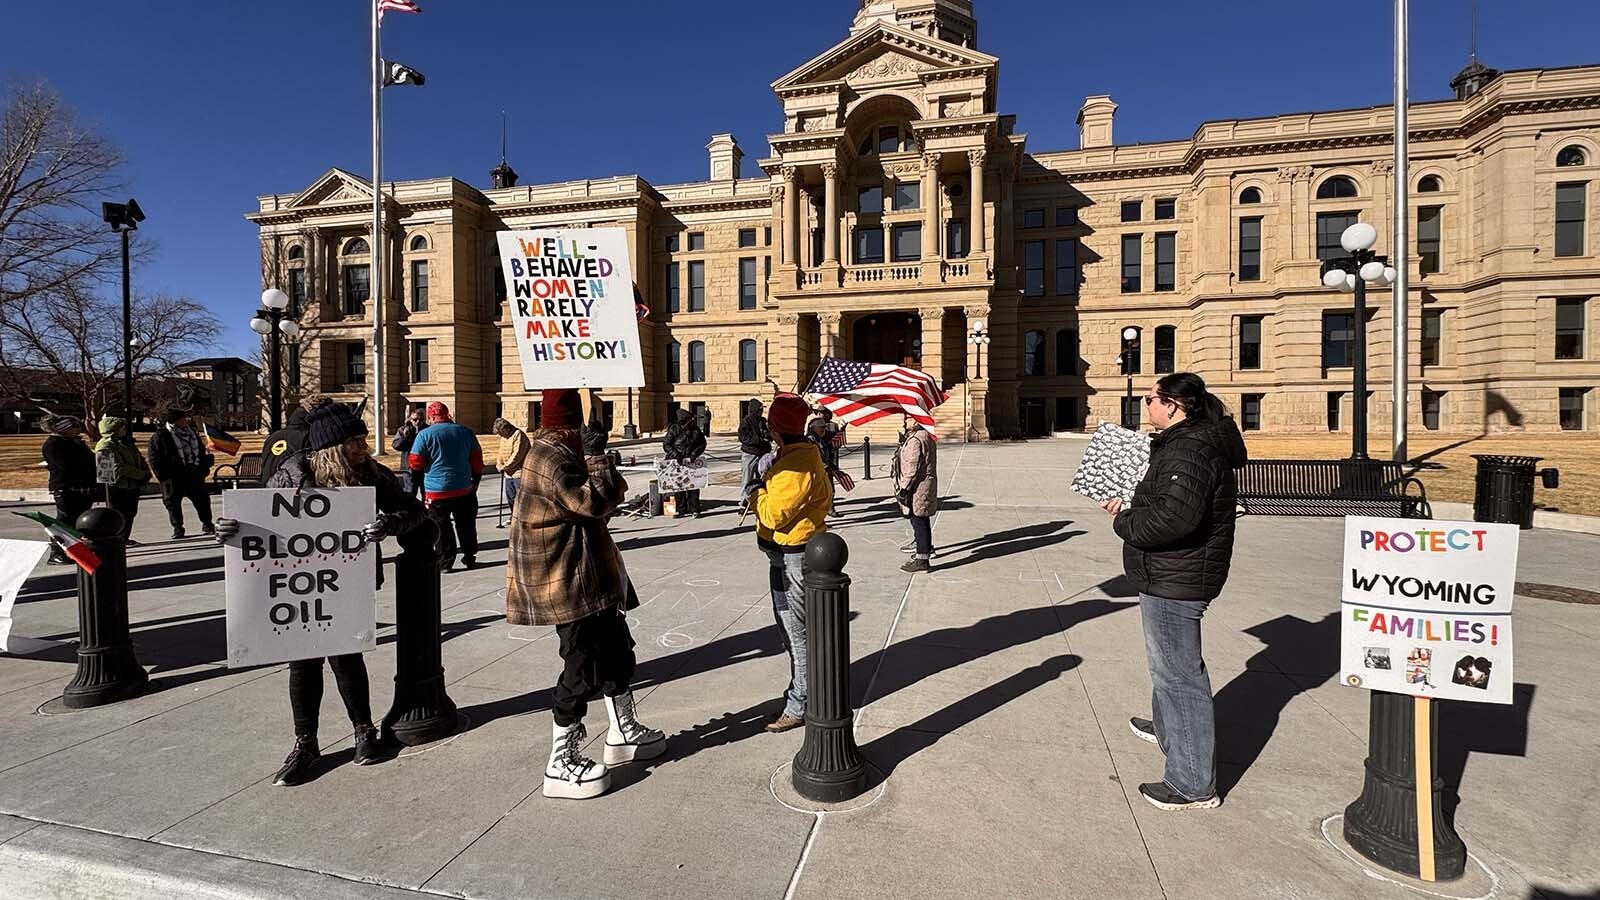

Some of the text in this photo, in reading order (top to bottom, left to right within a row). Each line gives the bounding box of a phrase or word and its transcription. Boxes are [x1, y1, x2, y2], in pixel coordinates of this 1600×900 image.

[510, 258, 613, 278] BEHAVED
[514, 279, 605, 299] WOMEN
[517, 298, 595, 317] RARELY
[526, 319, 591, 339] MAKE
[533, 340, 627, 361] HISTORY!
[271, 492, 331, 518] NO
[241, 530, 366, 561] BLOOD
[1360, 529, 1487, 552] PROTECT
[269, 569, 340, 598] FOR
[1352, 568, 1496, 605] WYOMING
[269, 598, 333, 625] OIL
